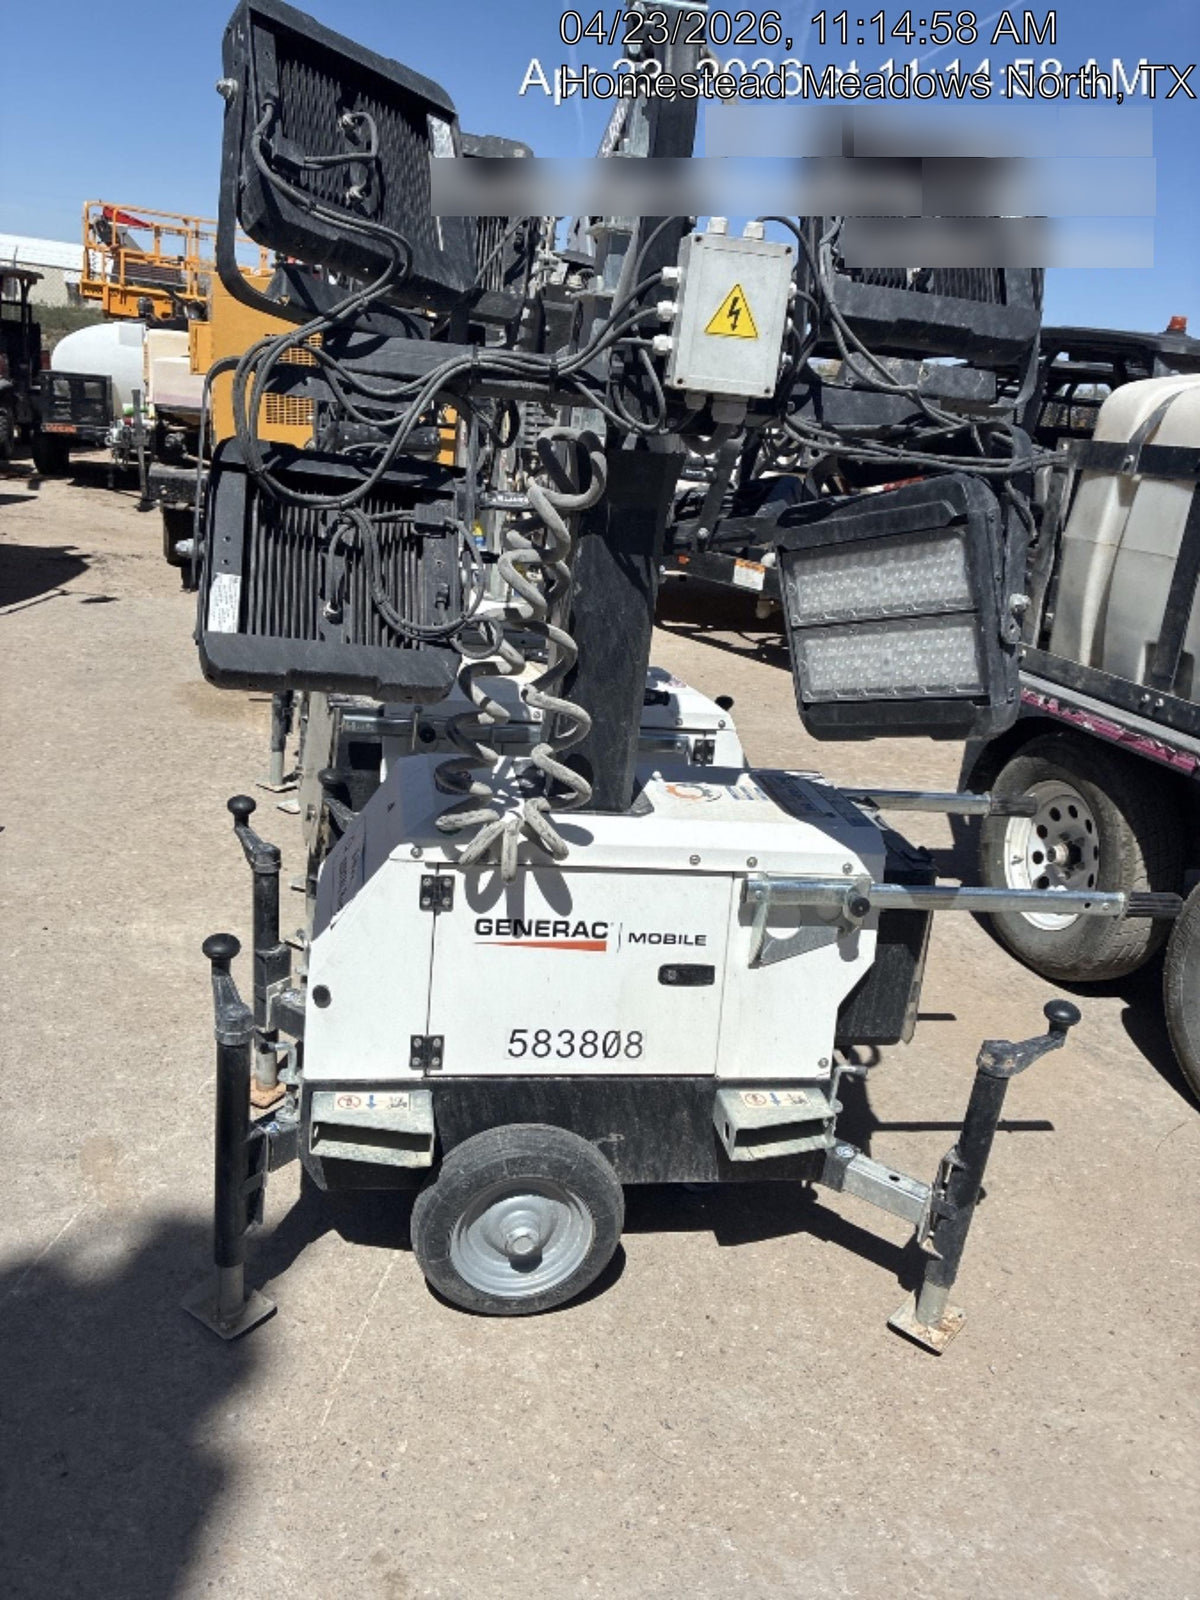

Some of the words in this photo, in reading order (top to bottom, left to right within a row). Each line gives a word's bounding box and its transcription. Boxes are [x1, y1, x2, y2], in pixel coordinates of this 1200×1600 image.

[474, 918, 609, 939] GENERAC
[628, 932, 707, 946] MOBILE
[507, 1028, 643, 1059] 583808
